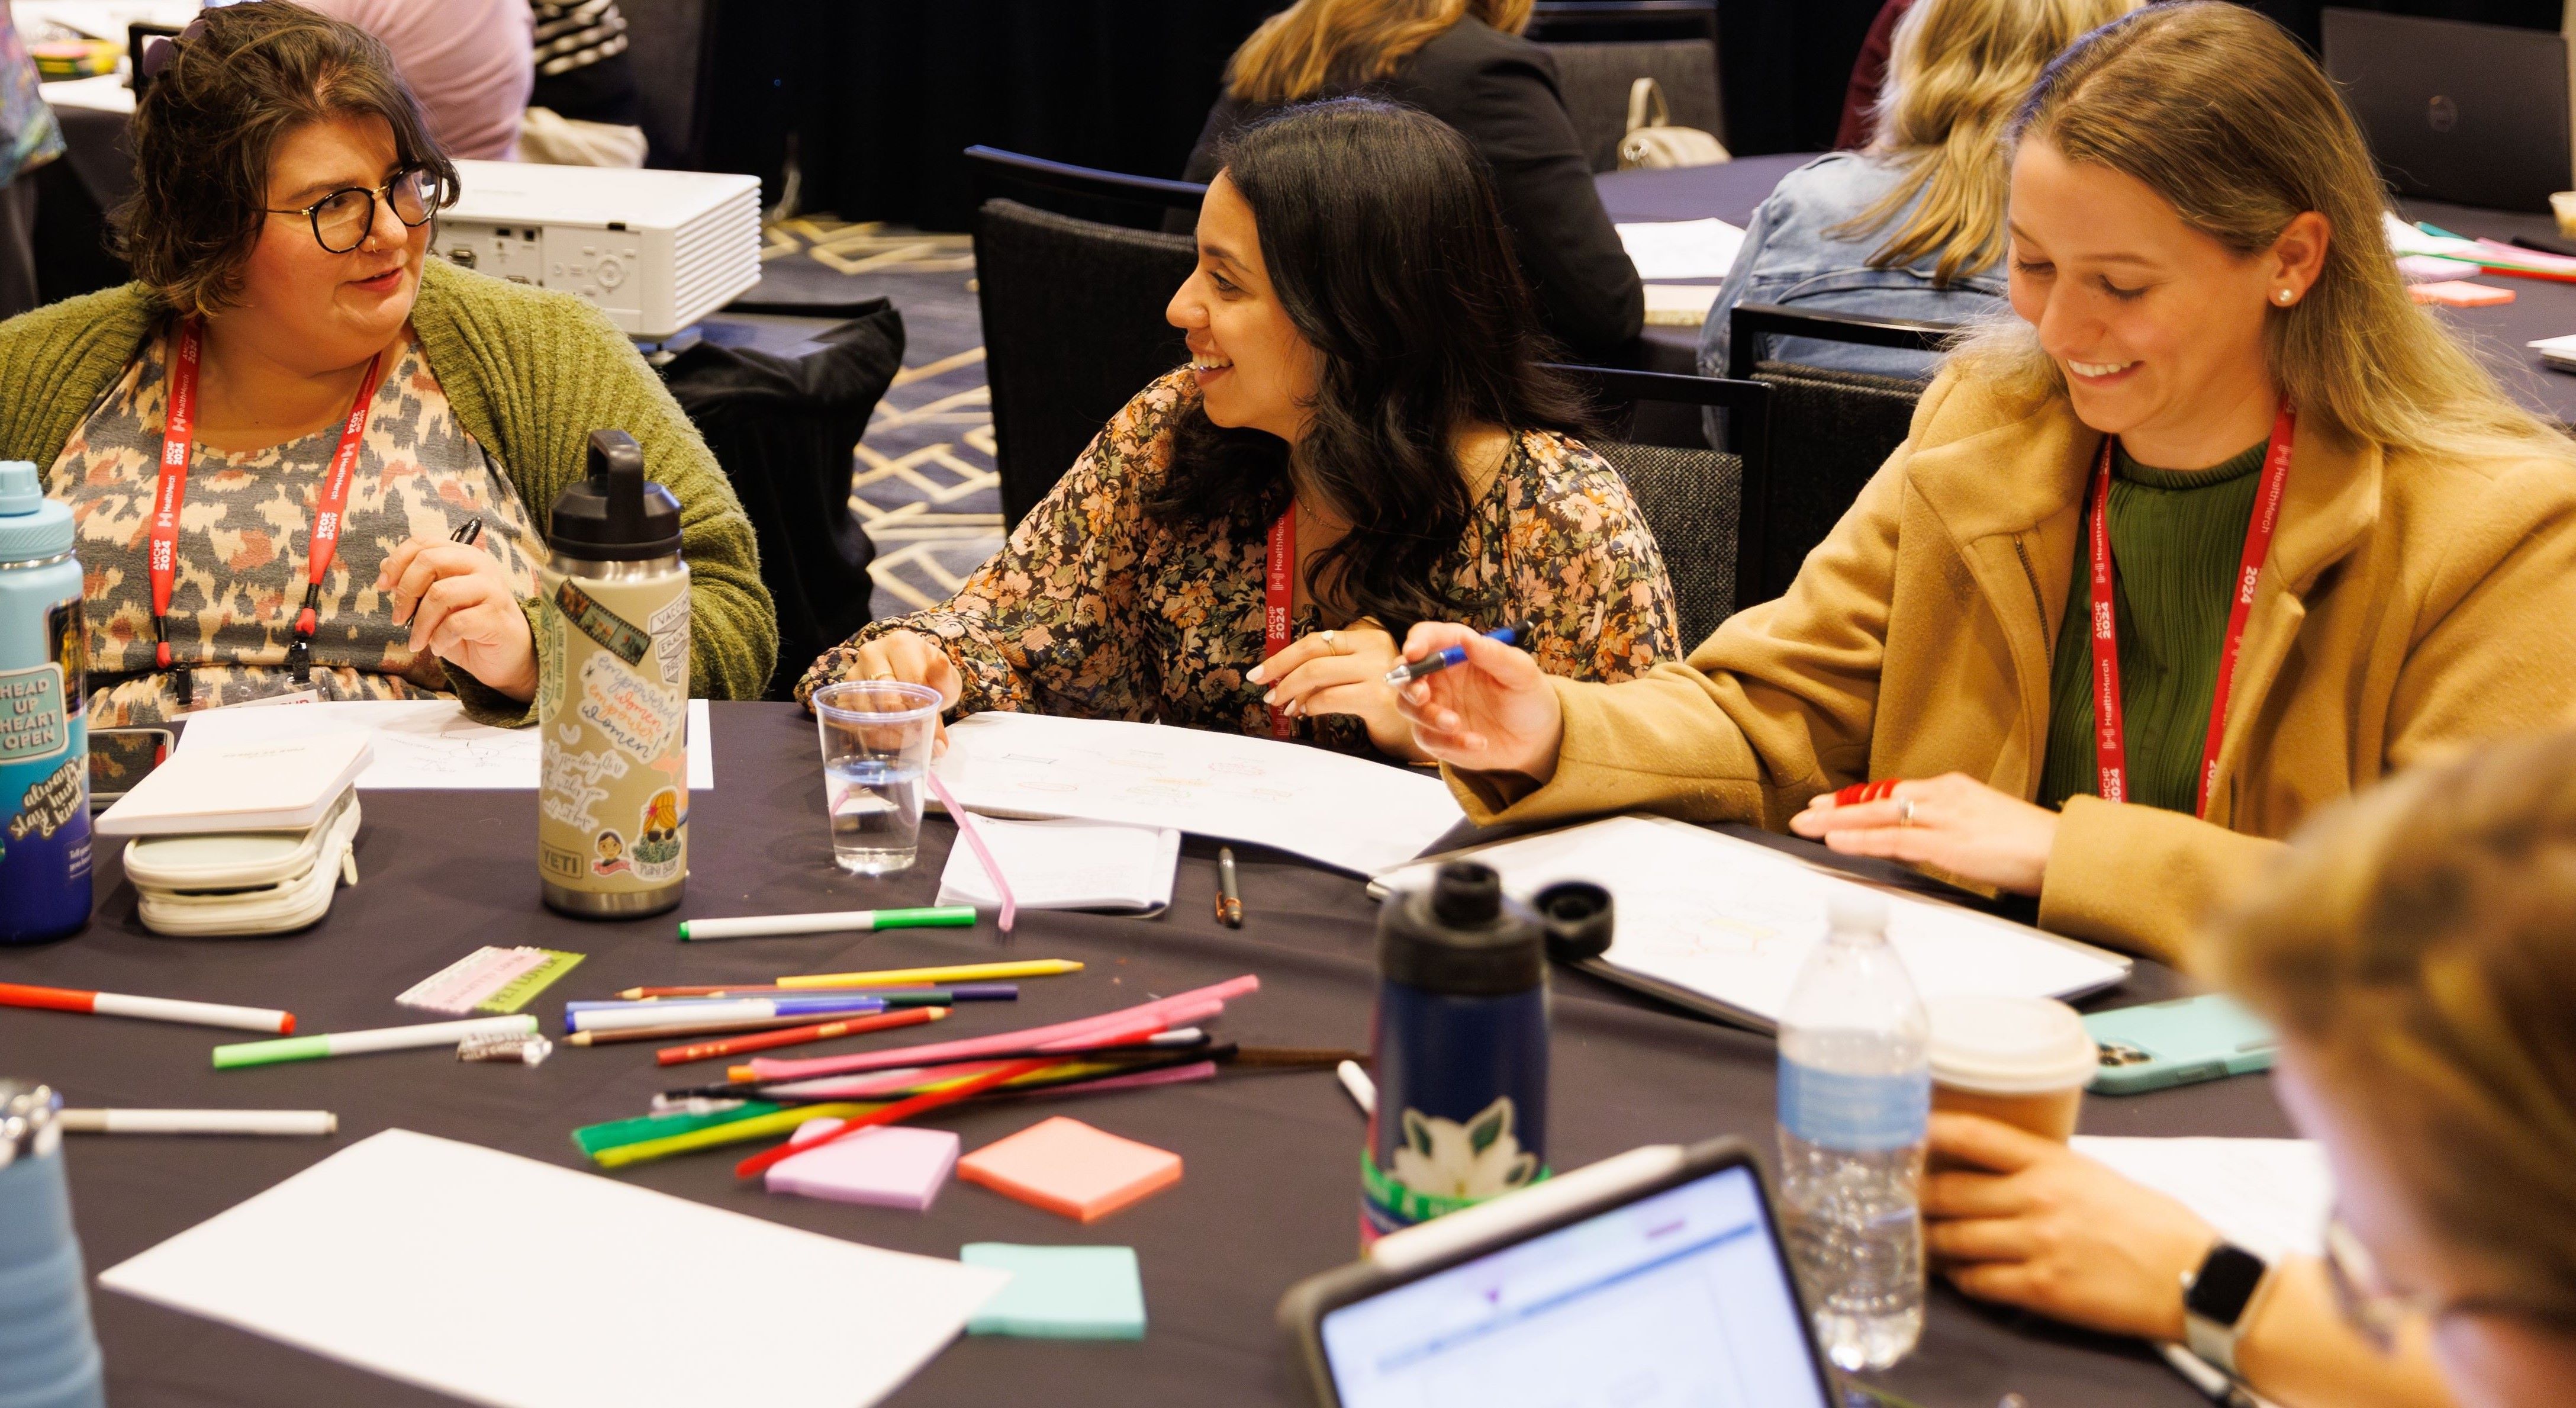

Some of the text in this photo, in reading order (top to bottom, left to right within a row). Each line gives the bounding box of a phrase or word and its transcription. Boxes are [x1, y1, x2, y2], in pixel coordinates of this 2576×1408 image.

[347, 412, 360, 435] 2024
[166, 441, 175, 465] AMCHP
[173, 443, 185, 465] 2024
[331, 458, 349, 500] HealthMerch
[163, 475, 176, 512] HealthMerch
[2261, 467, 2285, 533] HealthMerch
[317, 512, 329, 539] 2024
[327, 512, 338, 541] AMCHP
[153, 539, 162, 571] AMCHP
[160, 541, 171, 571] 2024
[2240, 565, 2258, 605] 2024
[1276, 606, 1285, 640] 2024
[2101, 602, 2111, 639] 2024
[0, 678, 49, 697] HEAD
[14, 697, 38, 714] UP
[0, 709, 56, 732] HEART
[4, 728, 54, 750] OPEN
[544, 850, 578, 874] YETI
